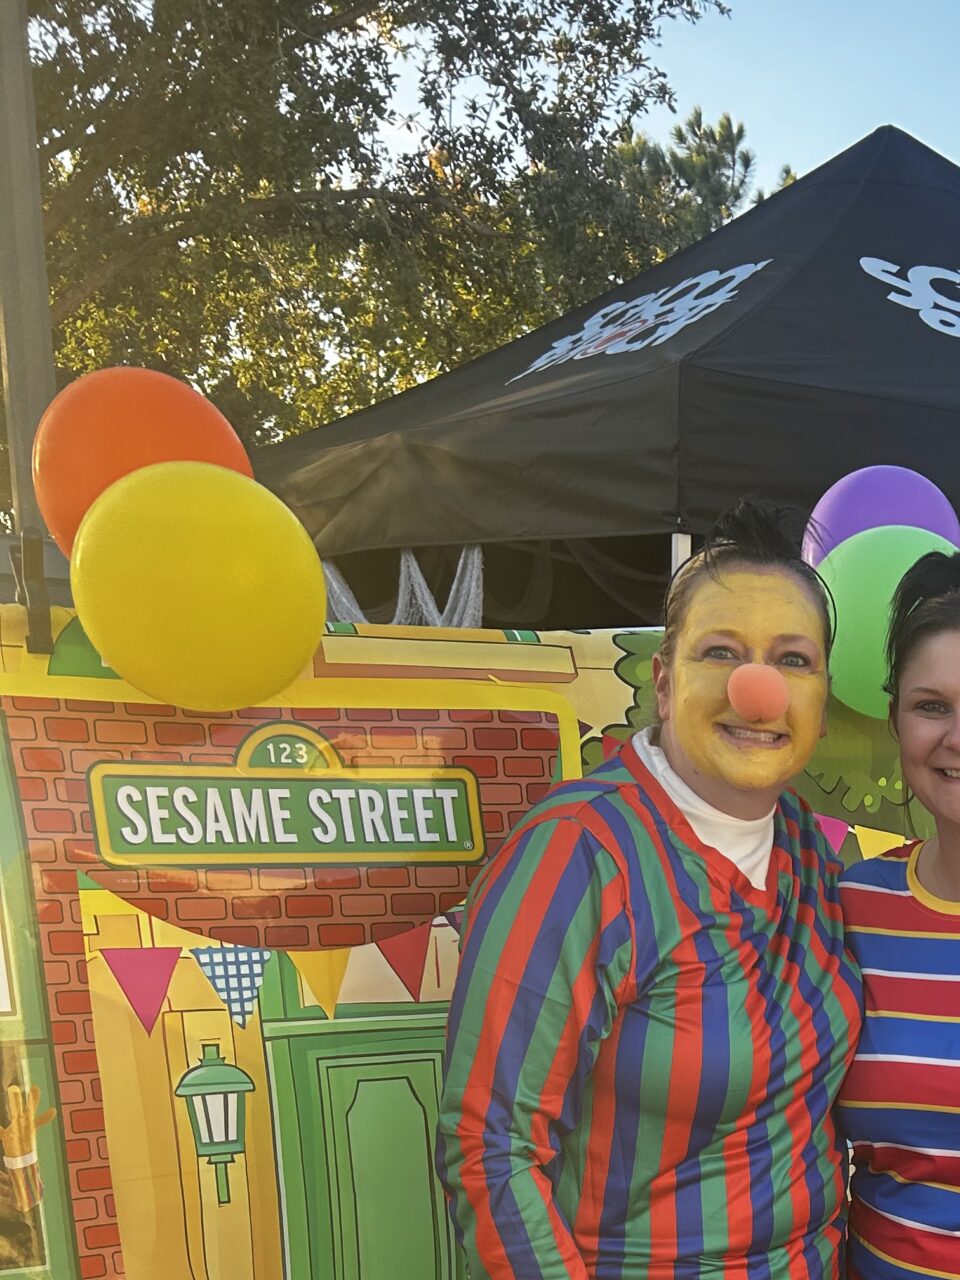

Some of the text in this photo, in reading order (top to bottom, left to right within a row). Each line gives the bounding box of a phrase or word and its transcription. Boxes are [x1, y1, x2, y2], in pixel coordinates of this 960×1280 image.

[266, 742, 308, 764] 123
[116, 785, 459, 844] SESAME STREET
